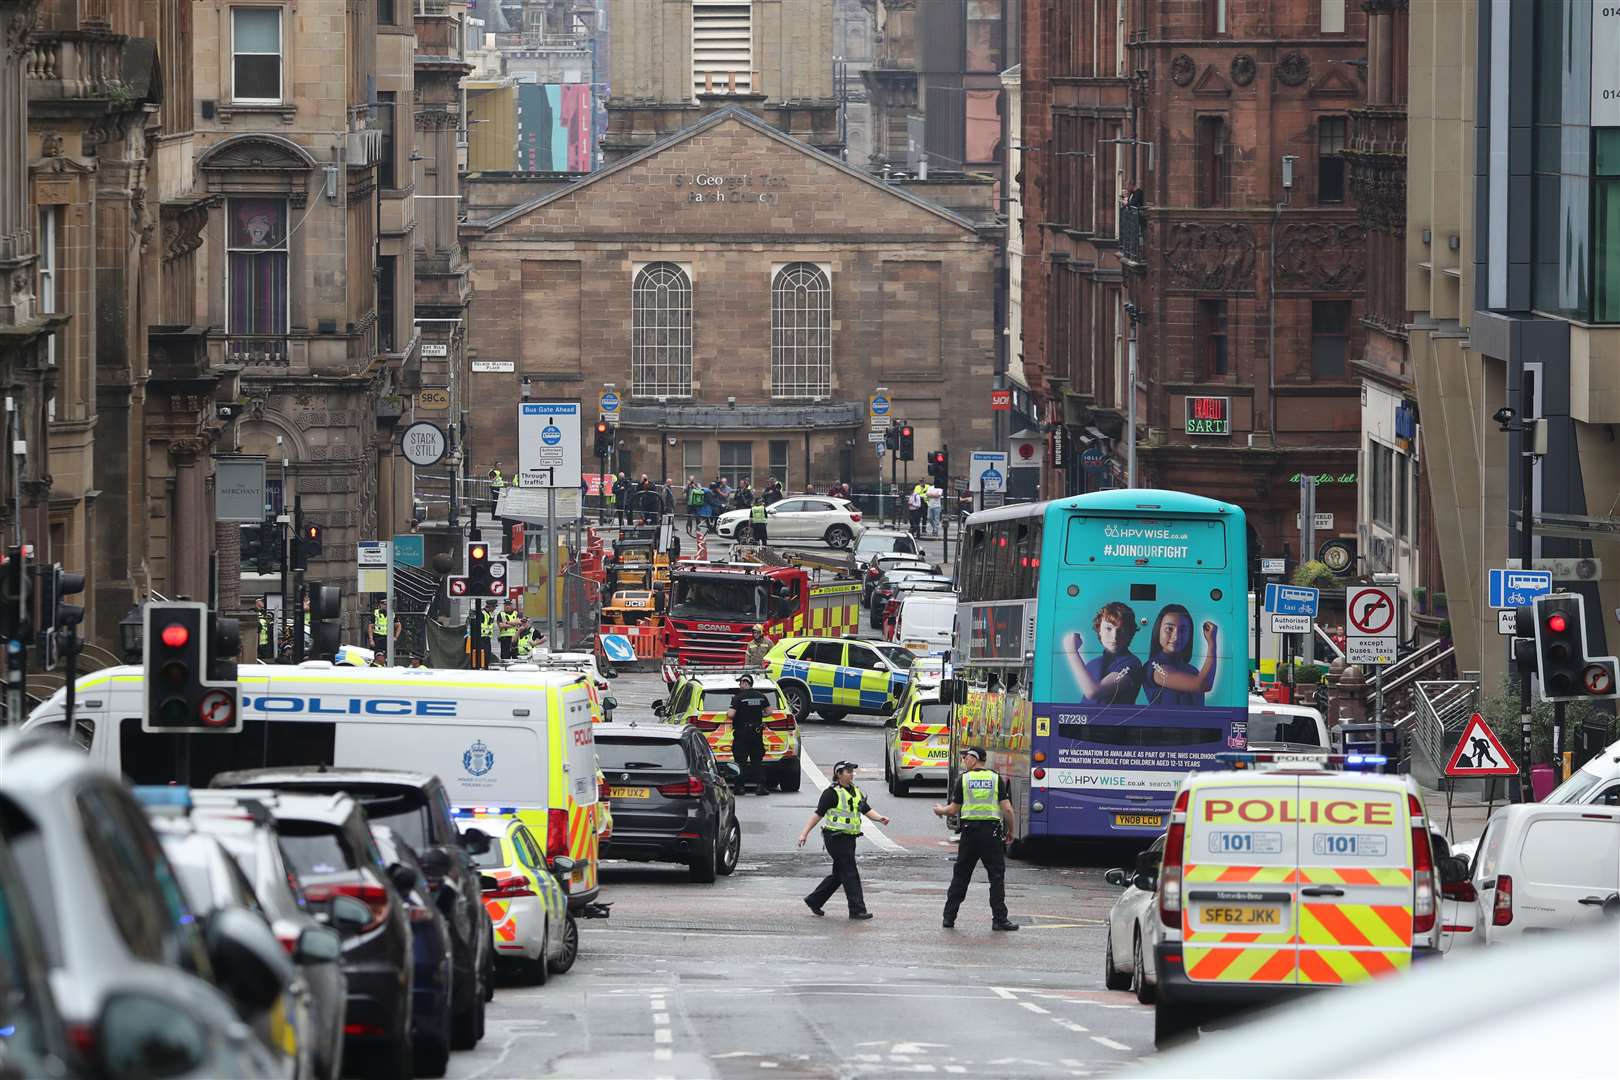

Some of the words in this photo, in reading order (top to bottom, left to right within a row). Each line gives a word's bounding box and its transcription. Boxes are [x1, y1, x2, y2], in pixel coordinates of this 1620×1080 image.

[1188, 419, 1228, 433] SARTI
[410, 432, 437, 445] STACK
[415, 444, 438, 457] STILL
[1103, 544, 1188, 558] #JOINOURFIGHT
[697, 623, 731, 632] SCANIA
[242, 696, 457, 716] OLICE
[1058, 714, 1087, 725] 37239
[1070, 749, 1103, 757] VACCINATION
[1110, 750, 1137, 758] AVAILABLE
[1092, 757, 1118, 765] SCHEDULE
[1183, 760, 1201, 768] YEARS
[969, 780, 992, 788] POLICE
[627, 788, 645, 798] UXZ
[1205, 799, 1393, 825] POLICE
[1119, 816, 1141, 825] YN08
[1142, 817, 1159, 825] LCU
[1222, 834, 1252, 850] 101
[1327, 836, 1357, 852] 101
[1206, 908, 1243, 922] SF62
[1247, 909, 1275, 922] JKK
